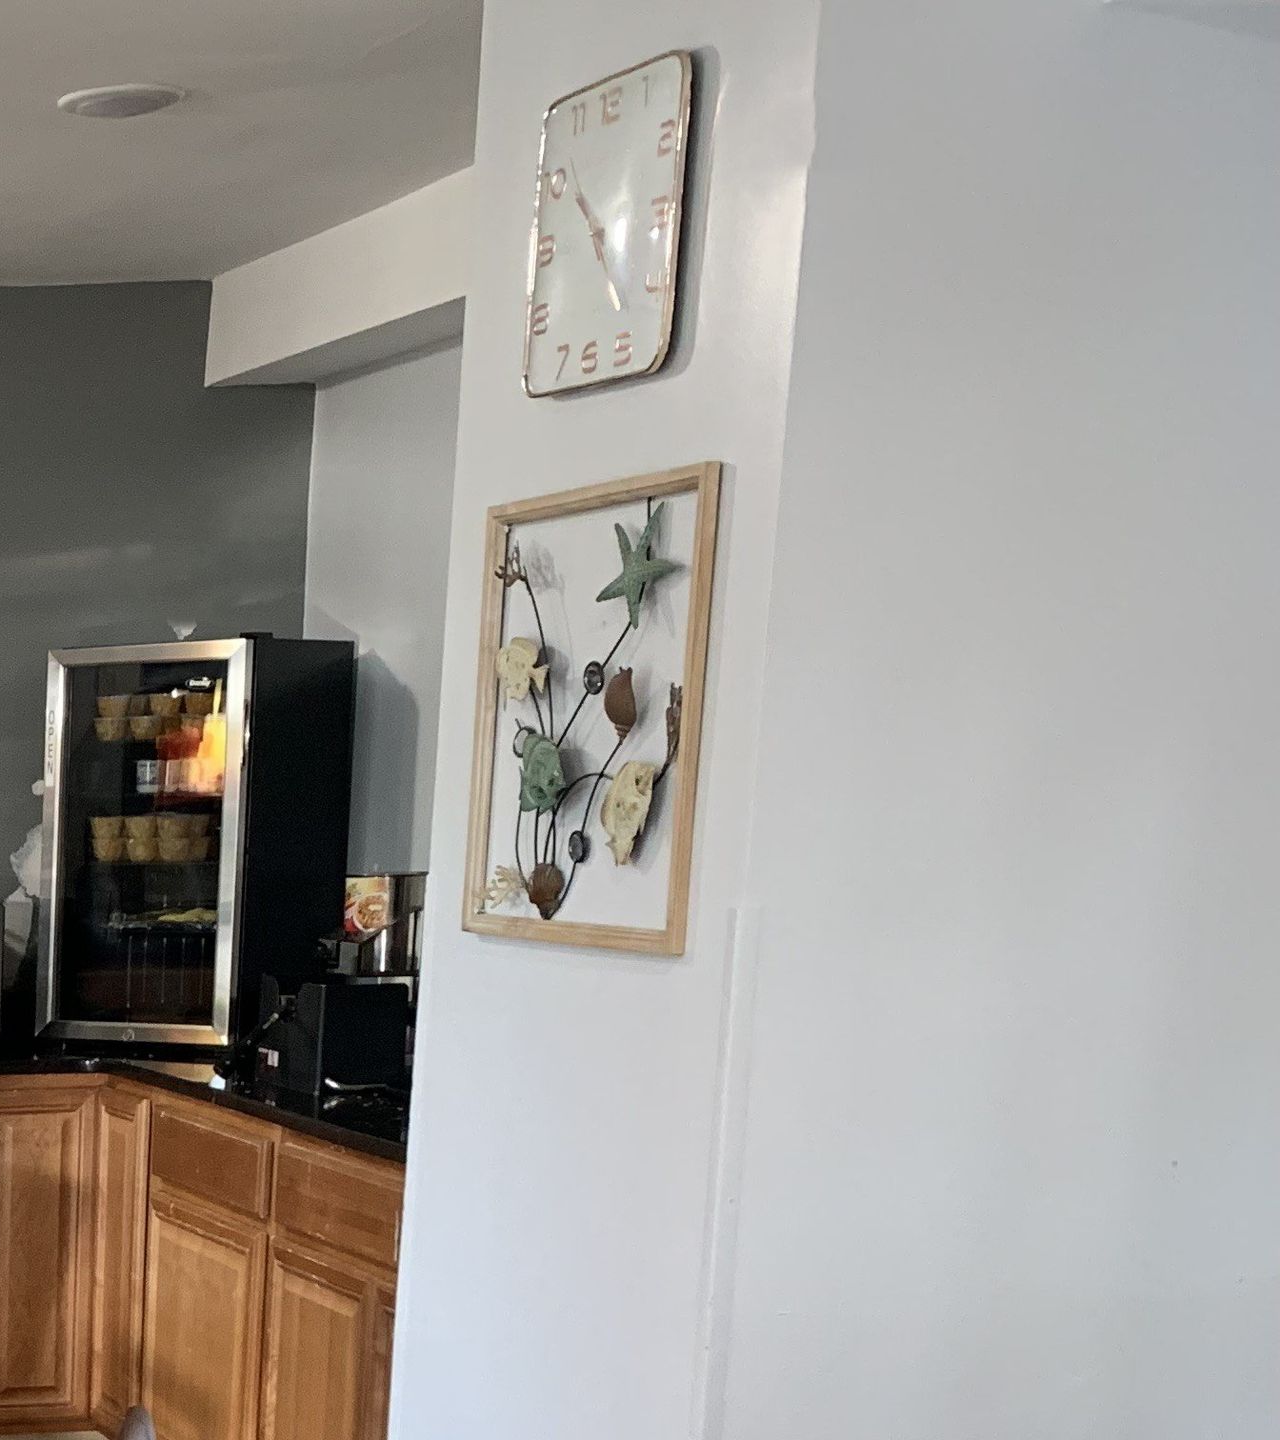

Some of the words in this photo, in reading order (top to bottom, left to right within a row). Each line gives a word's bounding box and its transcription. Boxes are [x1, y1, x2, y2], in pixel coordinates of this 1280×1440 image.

[571, 102, 587, 137] 11
[599, 86, 623, 126] 12
[657, 118, 676, 158] 2
[543, 167, 567, 203] 10
[539, 234, 556, 268] 9
[531, 302, 549, 336] 8
[556, 343, 570, 382] 7
[580, 340, 598, 375] 6
[613, 330, 633, 368] 5
